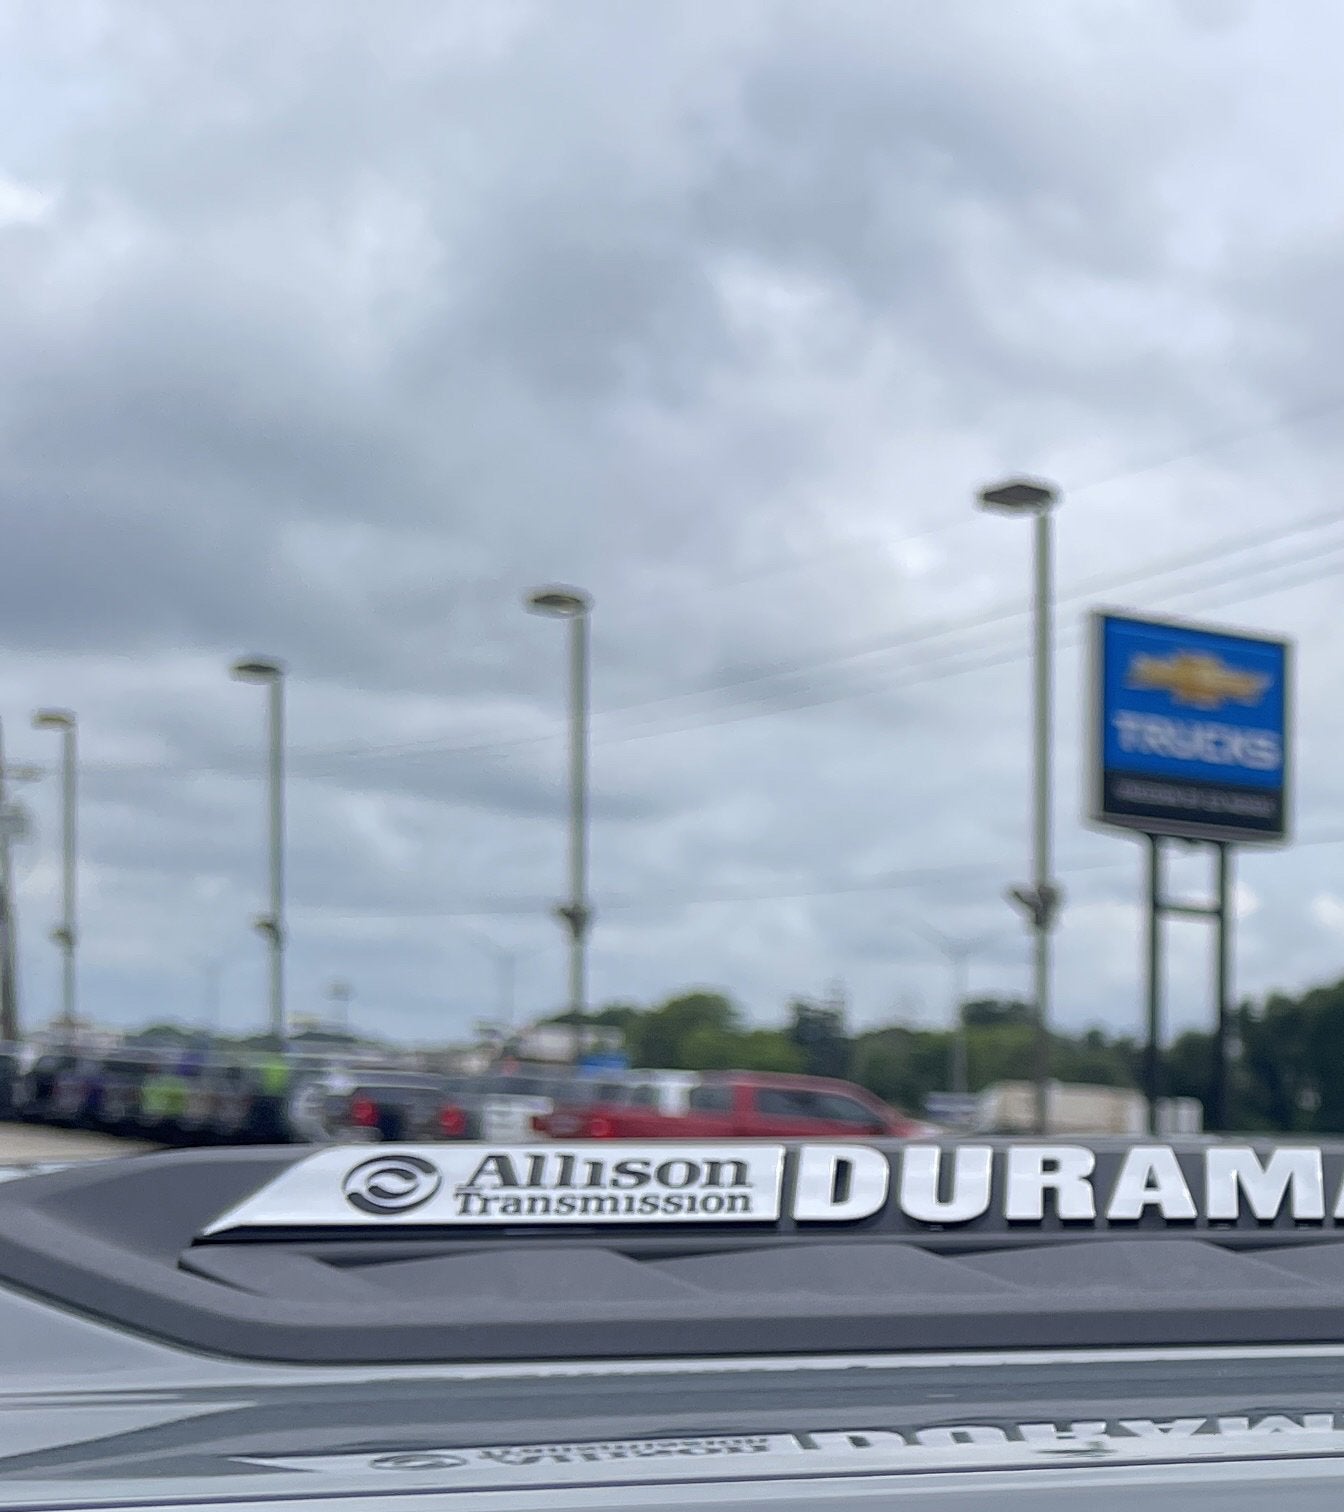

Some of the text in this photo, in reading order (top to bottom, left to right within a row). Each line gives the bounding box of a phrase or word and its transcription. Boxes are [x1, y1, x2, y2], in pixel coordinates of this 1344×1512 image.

[1112, 709, 1282, 771] TRUCKS
[457, 1152, 752, 1189] Allison
[455, 1190, 753, 1218] Transmission
